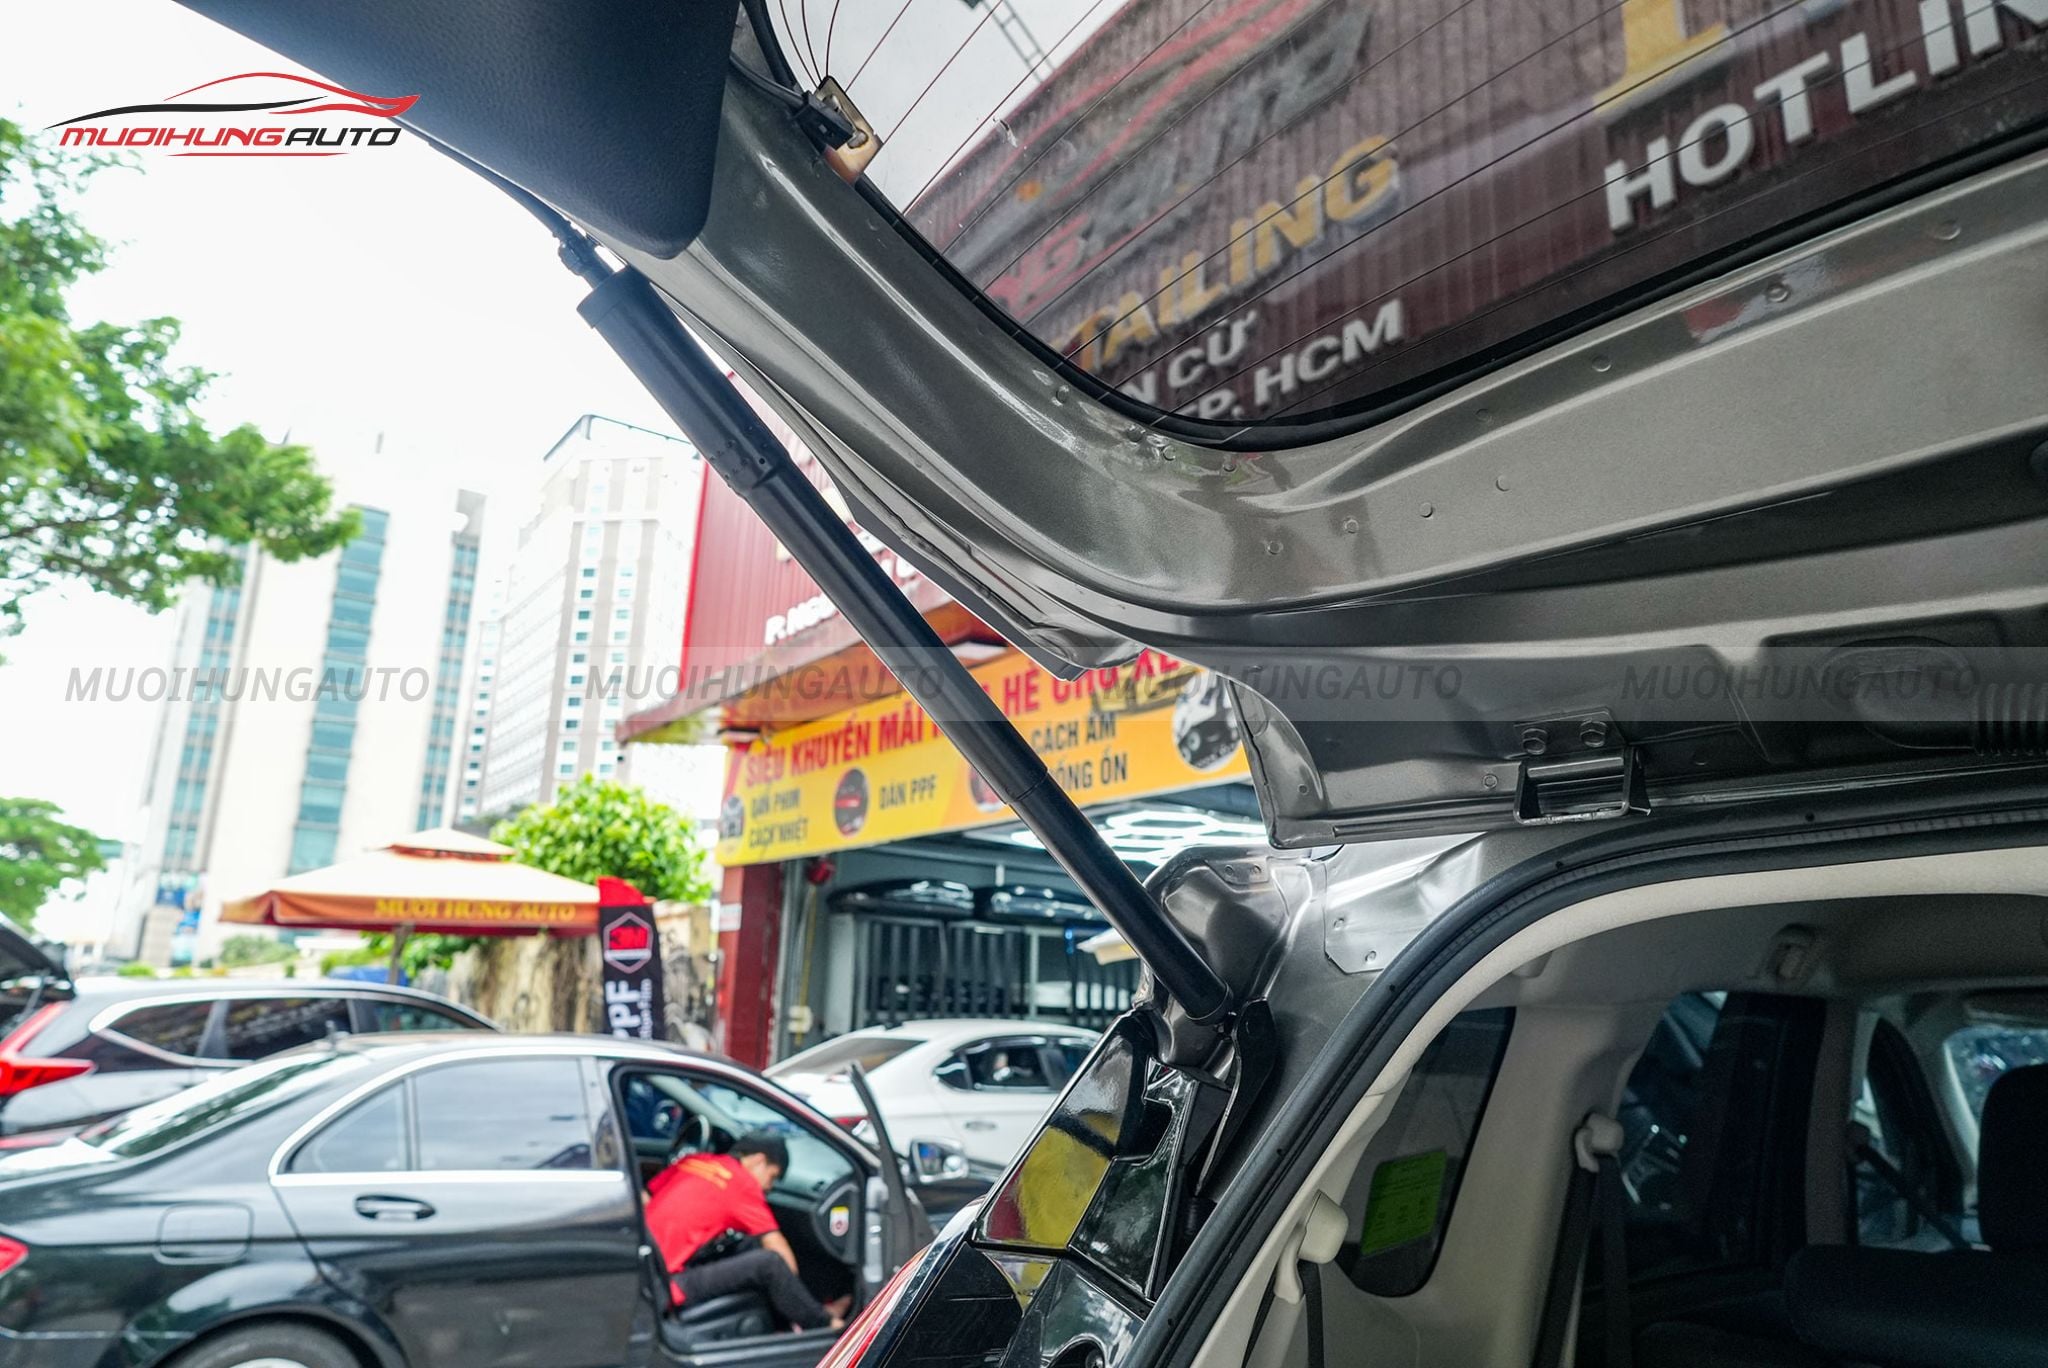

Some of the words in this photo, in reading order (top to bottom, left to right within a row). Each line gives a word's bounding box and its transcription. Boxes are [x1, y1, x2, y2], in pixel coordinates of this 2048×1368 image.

[1253, 298, 1402, 406] HCM
[791, 712, 872, 777] KHUYẾN
[910, 773, 939, 805] PPF
